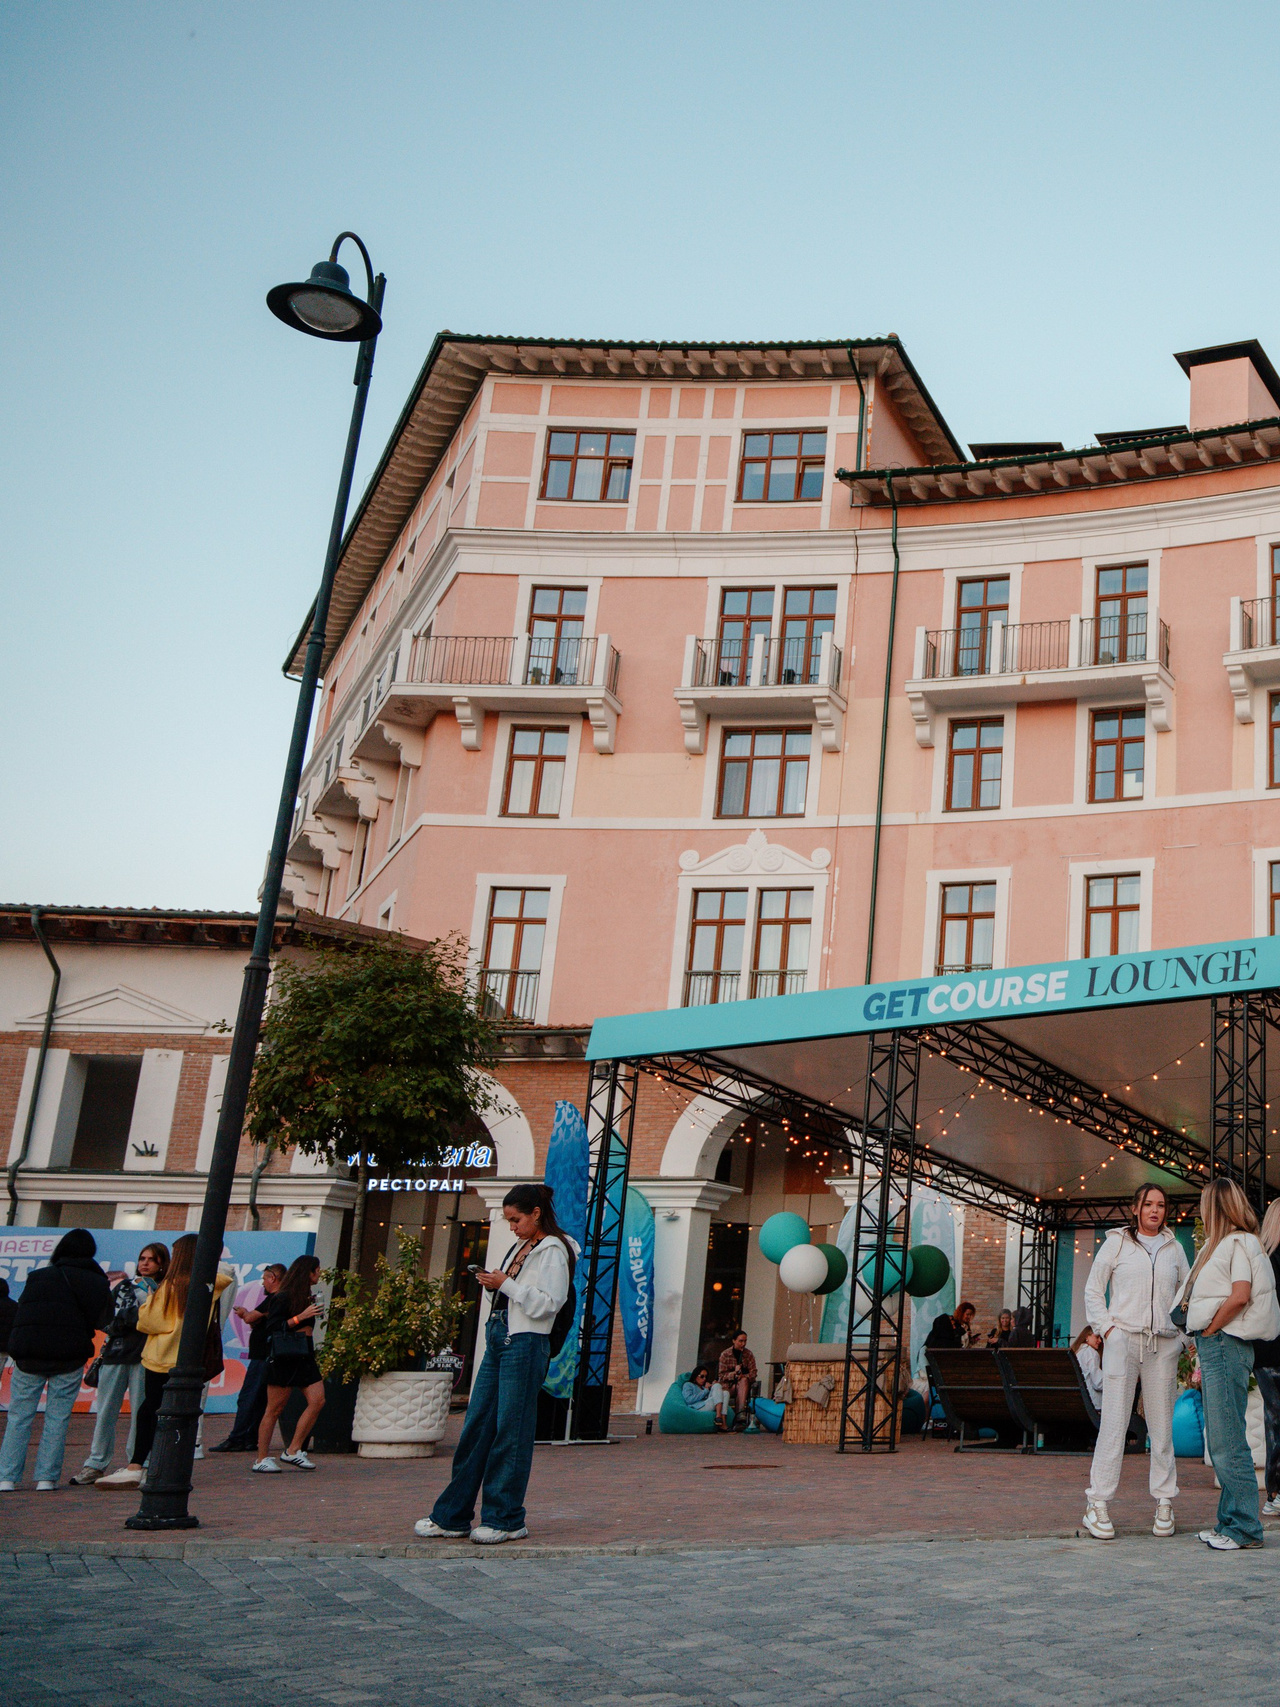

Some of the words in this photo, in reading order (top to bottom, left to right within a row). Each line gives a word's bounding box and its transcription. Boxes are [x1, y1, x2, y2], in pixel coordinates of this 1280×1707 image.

[863, 970, 1069, 1022] GETCOURSE
[1084, 947, 1257, 998] LOUNGE
[368, 1178, 464, 1191] РЕСТОРАН
[0, 1240, 54, 1253] АЕТЕ
